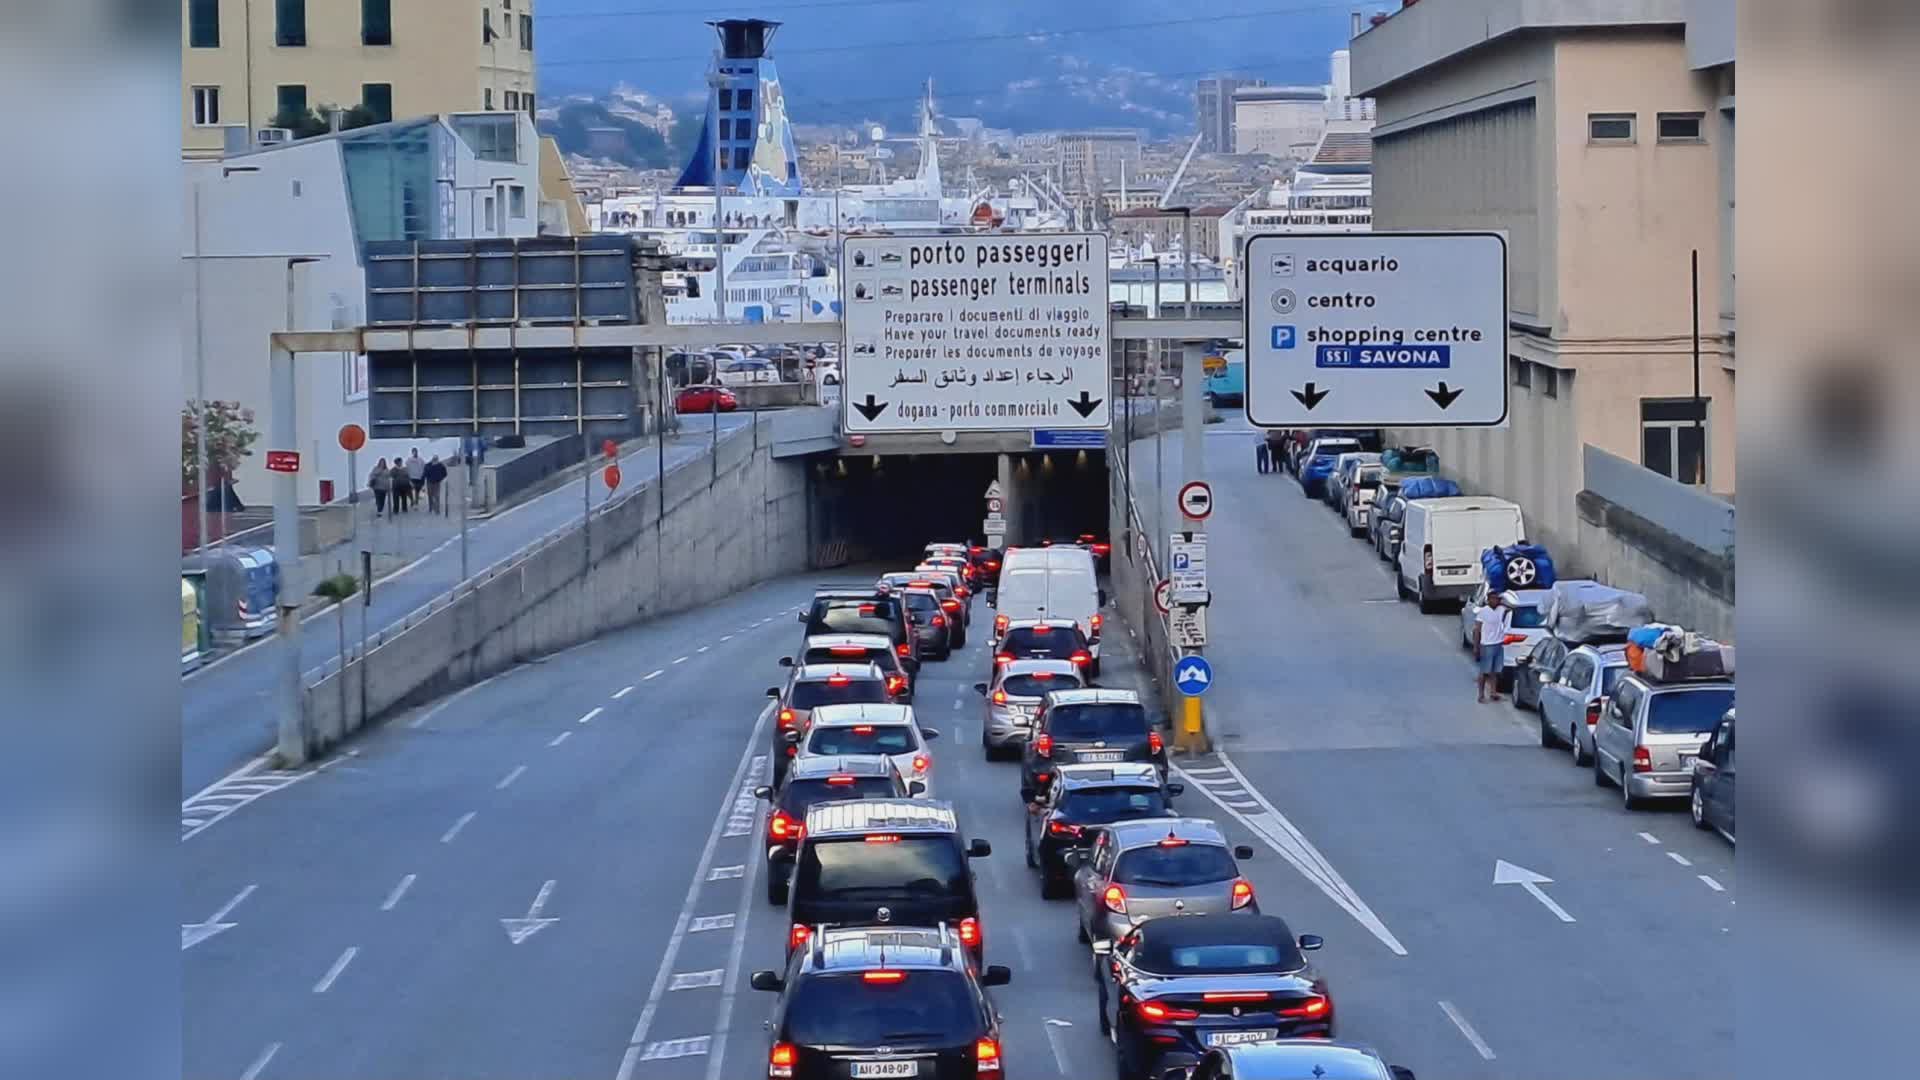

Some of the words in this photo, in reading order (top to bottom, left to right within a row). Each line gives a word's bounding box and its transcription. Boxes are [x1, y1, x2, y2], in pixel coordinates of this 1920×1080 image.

[910, 240, 965, 269] porto
[976, 237, 1090, 268] passeggeri
[1306, 256, 1399, 274] acquario
[910, 277, 997, 302] passenger
[1009, 270, 1090, 295] terminals
[1307, 292, 1376, 308] centro
[885, 310, 943, 325] Preparare
[959, 307, 1023, 322] documenti
[1029, 307, 1040, 321] di
[1046, 306, 1089, 323] viaggio
[884, 326, 914, 340] Have
[920, 329, 947, 344] your
[953, 325, 988, 339] travel
[994, 324, 1061, 339] documents
[1067, 323, 1100, 340] ready
[1307, 326, 1404, 345] shopping
[1414, 326, 1482, 342] centre
[943, 345, 961, 359] les
[966, 344, 1033, 358] documents
[1039, 343, 1053, 357] de
[1059, 345, 1101, 360] voyage
[1360, 349, 1441, 364] SAVONA
[888, 368, 927, 388] السفر
[934, 366, 977, 388] وثائق
[982, 368, 1019, 386] إعداد
[1026, 367, 1073, 386] الرجاء
[898, 400, 938, 422] dogana
[950, 400, 980, 421] porto
[984, 398, 1059, 417] commerciale
